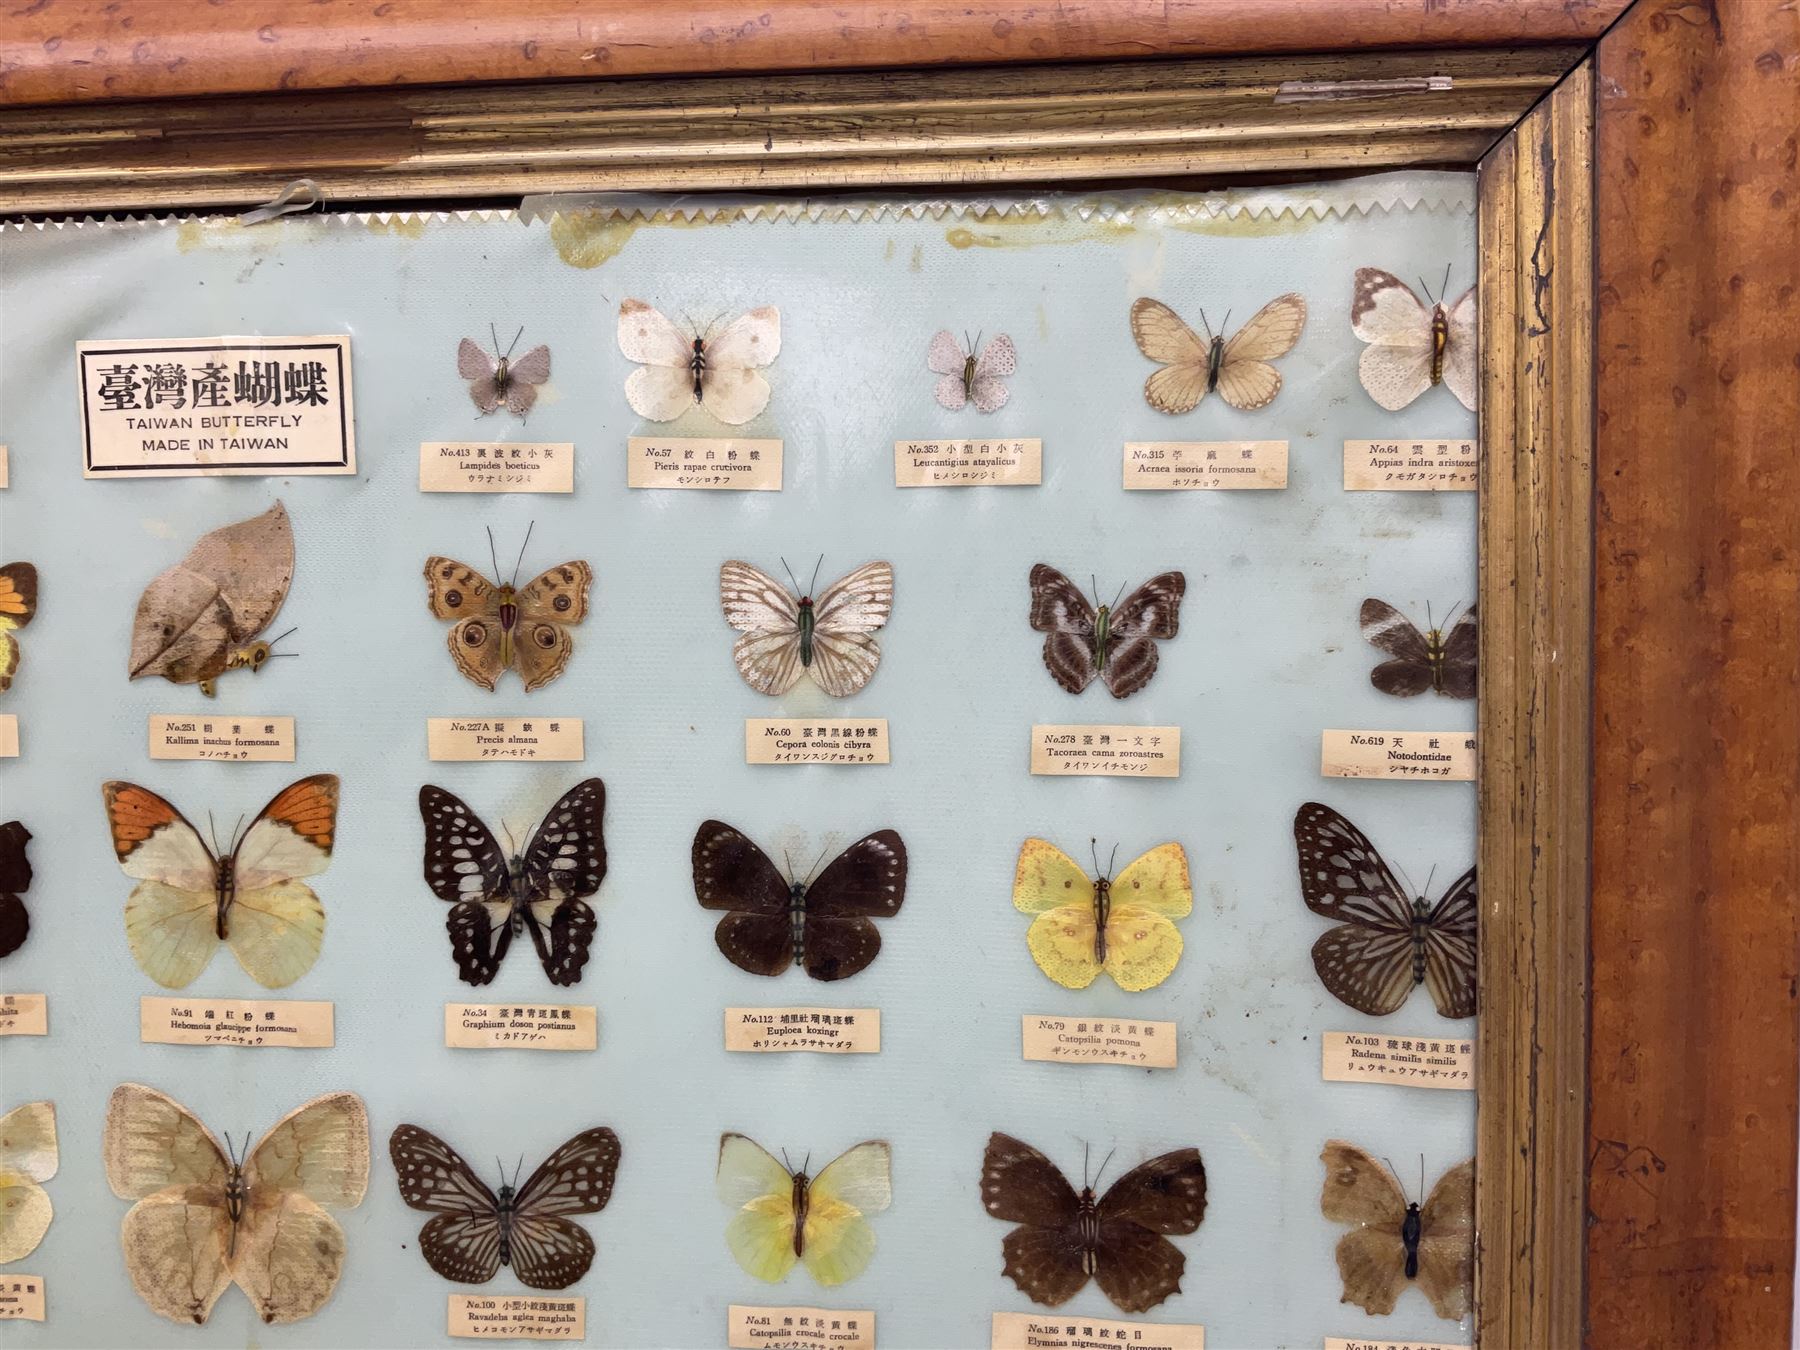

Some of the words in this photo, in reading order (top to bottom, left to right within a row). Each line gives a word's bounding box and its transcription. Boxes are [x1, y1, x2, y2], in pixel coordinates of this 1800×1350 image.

[126, 418, 192, 429] TAIWAN
[202, 415, 302, 428] BUTTERFLY
[142, 440, 190, 451] MADE
[199, 439, 214, 450] IN
[220, 437, 288, 449] TAIWAN
[440, 448, 470, 456] No.413
[645, 448, 671, 457] No.57
[907, 445, 939, 454] No.352
[1369, 445, 1398, 454] No.64
[1132, 451, 1164, 459] No.315
[460, 461, 500, 470] Lampides
[654, 462, 679, 471] Pieris
[684, 464, 706, 472] rapae
[913, 458, 969, 467] Leucantigius
[973, 458, 1015, 467] atayalicus
[1370, 458, 1403, 468] Appias
[1408, 458, 1433, 467] indra
[1138, 464, 1170, 473] Acraea
[1175, 465, 1203, 473] issoria
[1209, 465, 1256, 473] formosana
[166, 723, 195, 731] No.251
[451, 723, 490, 731] No.227A
[765, 728, 791, 736] No.60
[166, 736, 199, 744] Kallima
[204, 737, 231, 745] inachus
[235, 738, 279, 746] formosana
[477, 735, 504, 744] Precis
[508, 735, 538, 744] almana
[1044, 735, 1075, 743] No.278
[1350, 735, 1384, 745] No.619
[776, 740, 807, 750] Cepora
[844, 741, 871, 750] cibyra
[1046, 748, 1087, 756] Tacoraea
[1119, 750, 1164, 758] zoroastres
[1388, 751, 1451, 761] Notodontidae
[171, 1008, 192, 1017] No.91
[463, 1008, 487, 1016] No.34
[742, 1014, 773, 1023] No.112
[170, 1021, 211, 1030] Hebomoia
[463, 1020, 505, 1030] Graphium
[510, 1020, 533, 1028] doson
[538, 1021, 576, 1030] postianus
[1039, 1021, 1065, 1030] No.79
[1058, 1035, 1101, 1045] Catopsilia
[1106, 1038, 1141, 1047] pomona
[1346, 1035, 1379, 1046] No.103
[1352, 1049, 1386, 1059] Radena
[1391, 1053, 1422, 1063] similis
[1426, 1057, 1456, 1065] similis
[466, 1301, 495, 1309] No.100
[746, 1316, 770, 1325] No.81
[1028, 1324, 1059, 1334] No.186
[750, 1328, 791, 1338] Catopsilia
[796, 1330, 825, 1338] crocale
[829, 1332, 859, 1340] crocale
[1027, 1337, 1068, 1347] Elymnias
